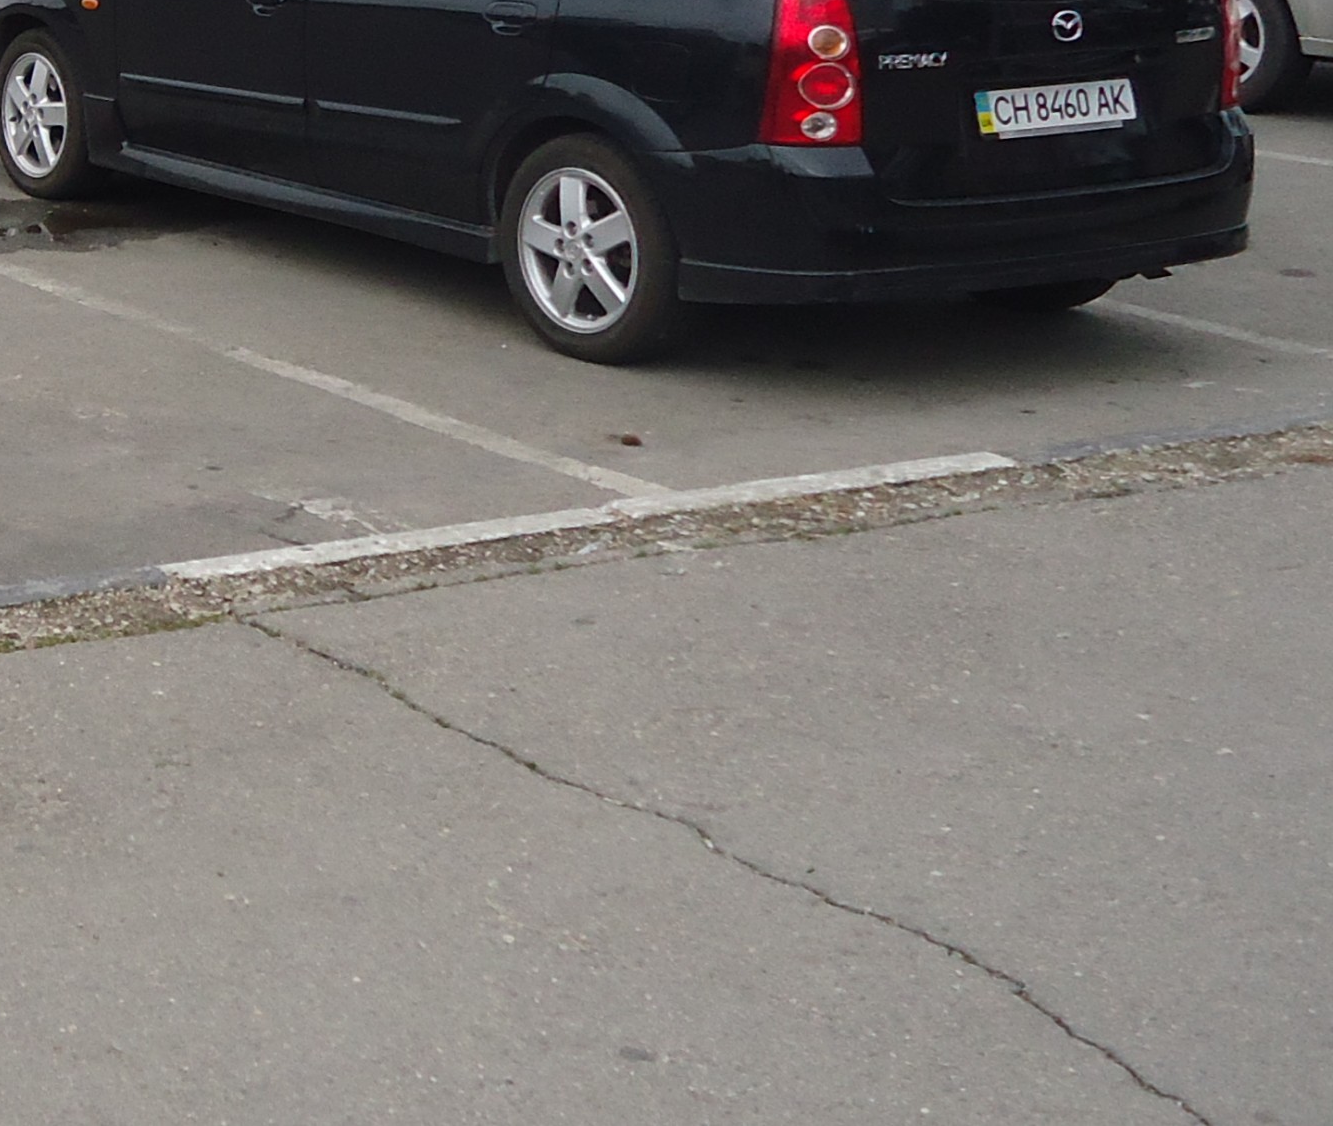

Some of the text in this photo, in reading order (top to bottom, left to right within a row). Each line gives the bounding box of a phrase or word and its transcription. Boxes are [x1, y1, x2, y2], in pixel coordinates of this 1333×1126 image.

[993, 84, 1130, 126] CH 8460 AK
